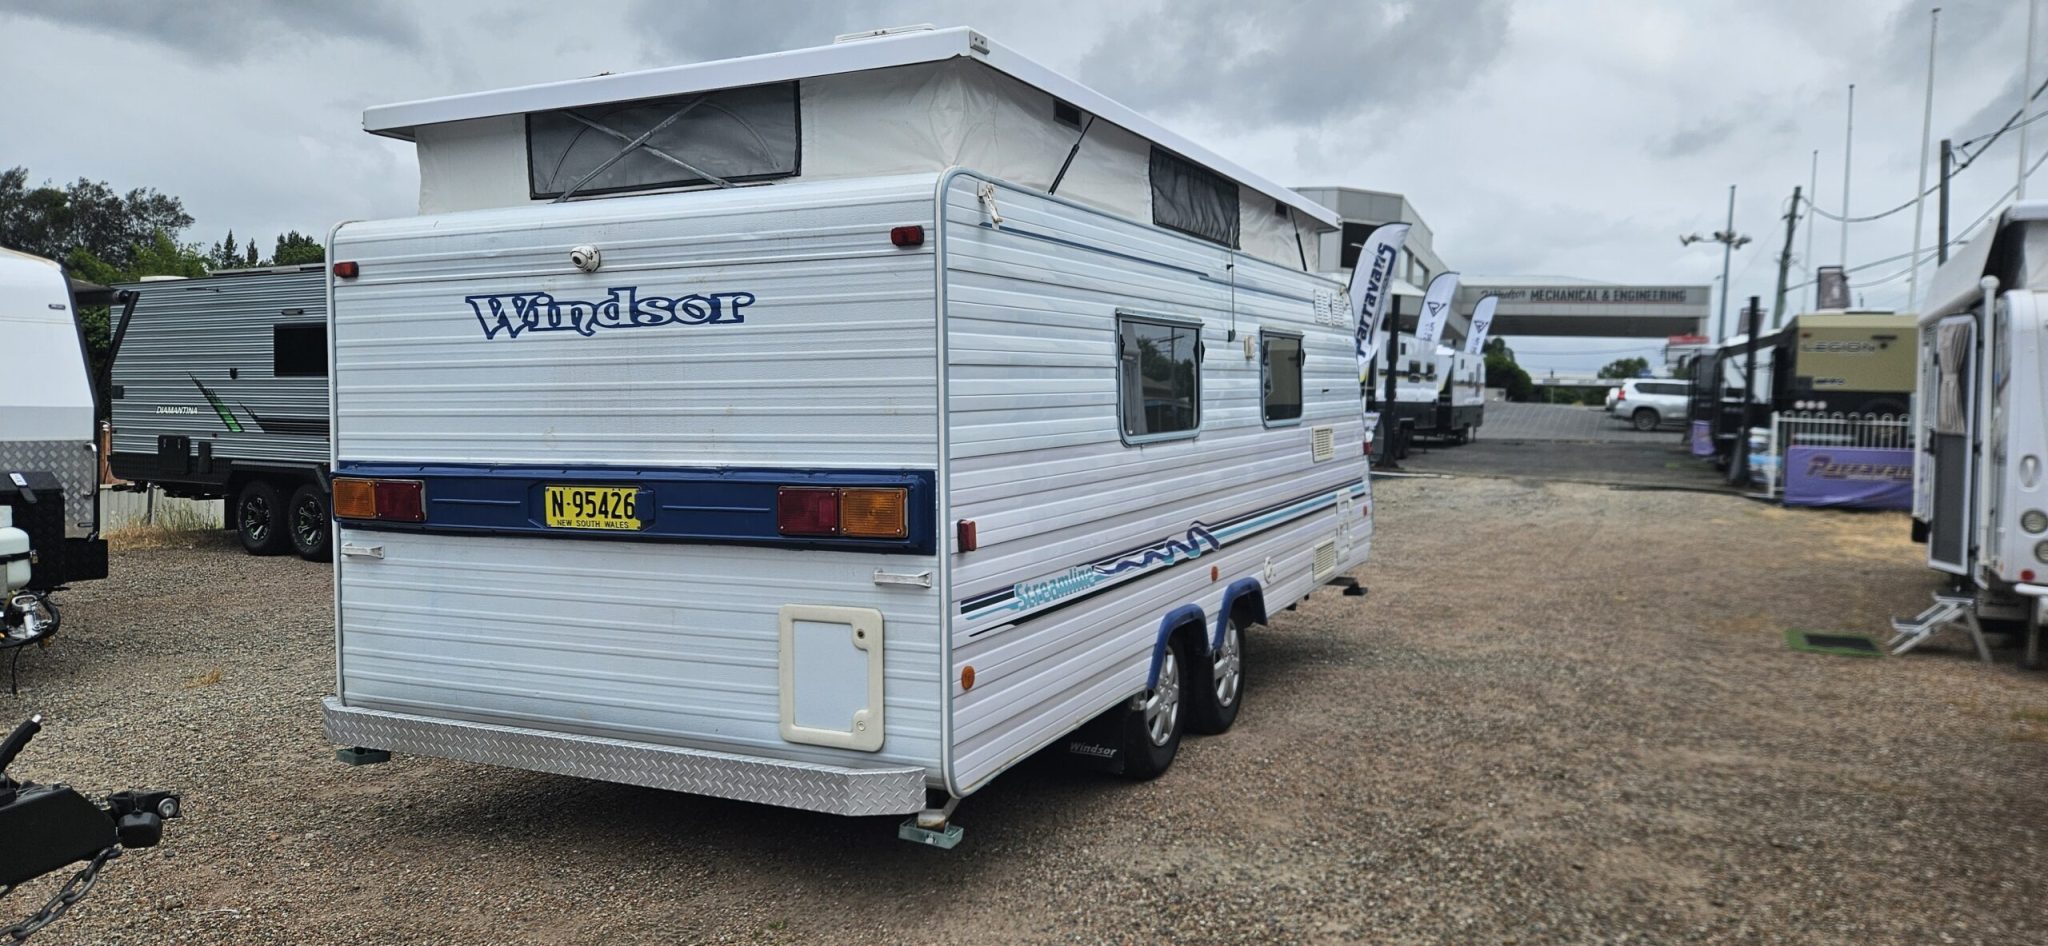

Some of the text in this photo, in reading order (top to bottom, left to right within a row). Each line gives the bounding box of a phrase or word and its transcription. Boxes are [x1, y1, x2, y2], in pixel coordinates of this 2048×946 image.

[1356, 242, 1397, 358] Parravans
[1530, 290, 1598, 301] MECHANICAL
[1602, 290, 1610, 301] &
[1614, 290, 1687, 301] ENGINEERING
[465, 286, 756, 340] Windsor
[156, 405, 198, 415] DIAMANTINA
[557, 519, 629, 529] NEW SOUTH WALES
[1014, 565, 1097, 612] Streamline
[1070, 742, 1118, 757] Windsor
